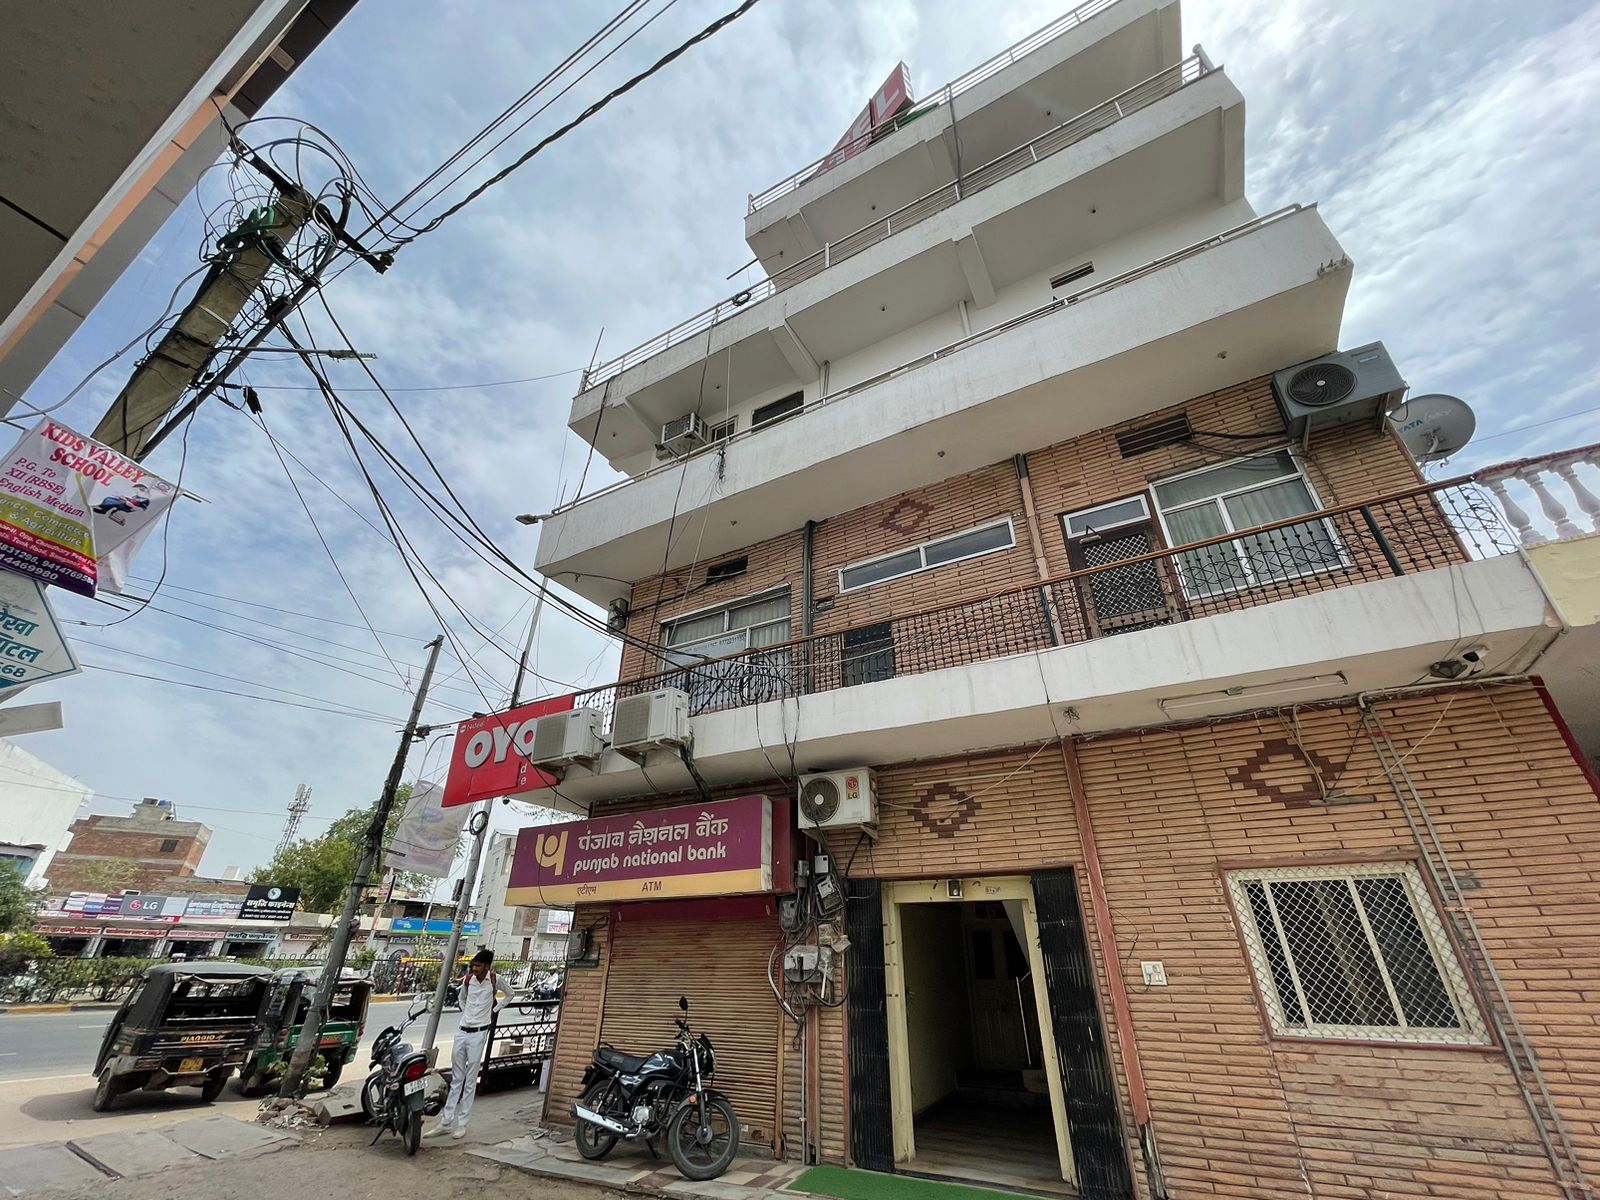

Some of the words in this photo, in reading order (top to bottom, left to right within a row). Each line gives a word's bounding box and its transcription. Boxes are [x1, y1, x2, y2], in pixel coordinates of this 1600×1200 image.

[1399, 419, 1424, 433] TATA
[40, 422, 87, 452] KIDS
[88, 445, 147, 484] VALLEY
[49, 447, 116, 487] SCHOOL
[5, 467, 27, 480] XII
[25, 475, 66, 496] (RBSE)
[15, 457, 37, 472] P.G.
[41, 467, 57, 478] To
[0, 477, 42, 499] English
[42, 495, 85, 518] Medium
[10, 511, 19, 520] &
[22, 517, 82, 546] Agriculture
[34, 511, 90, 538] Commerce
[0, 662, 26, 678] 68
[464, 718, 538, 769] OYO
[847, 791, 858, 800] LG
[578, 829, 625, 850] पंजाब
[628, 820, 690, 846] नैशनल
[695, 811, 729, 838] बैंक
[572, 853, 620, 877] punjab
[622, 845, 683, 868] national
[687, 841, 727, 862] bank
[576, 884, 597, 897] एटीएम
[641, 881, 662, 893] ATM
[142, 901, 159, 910] LG
